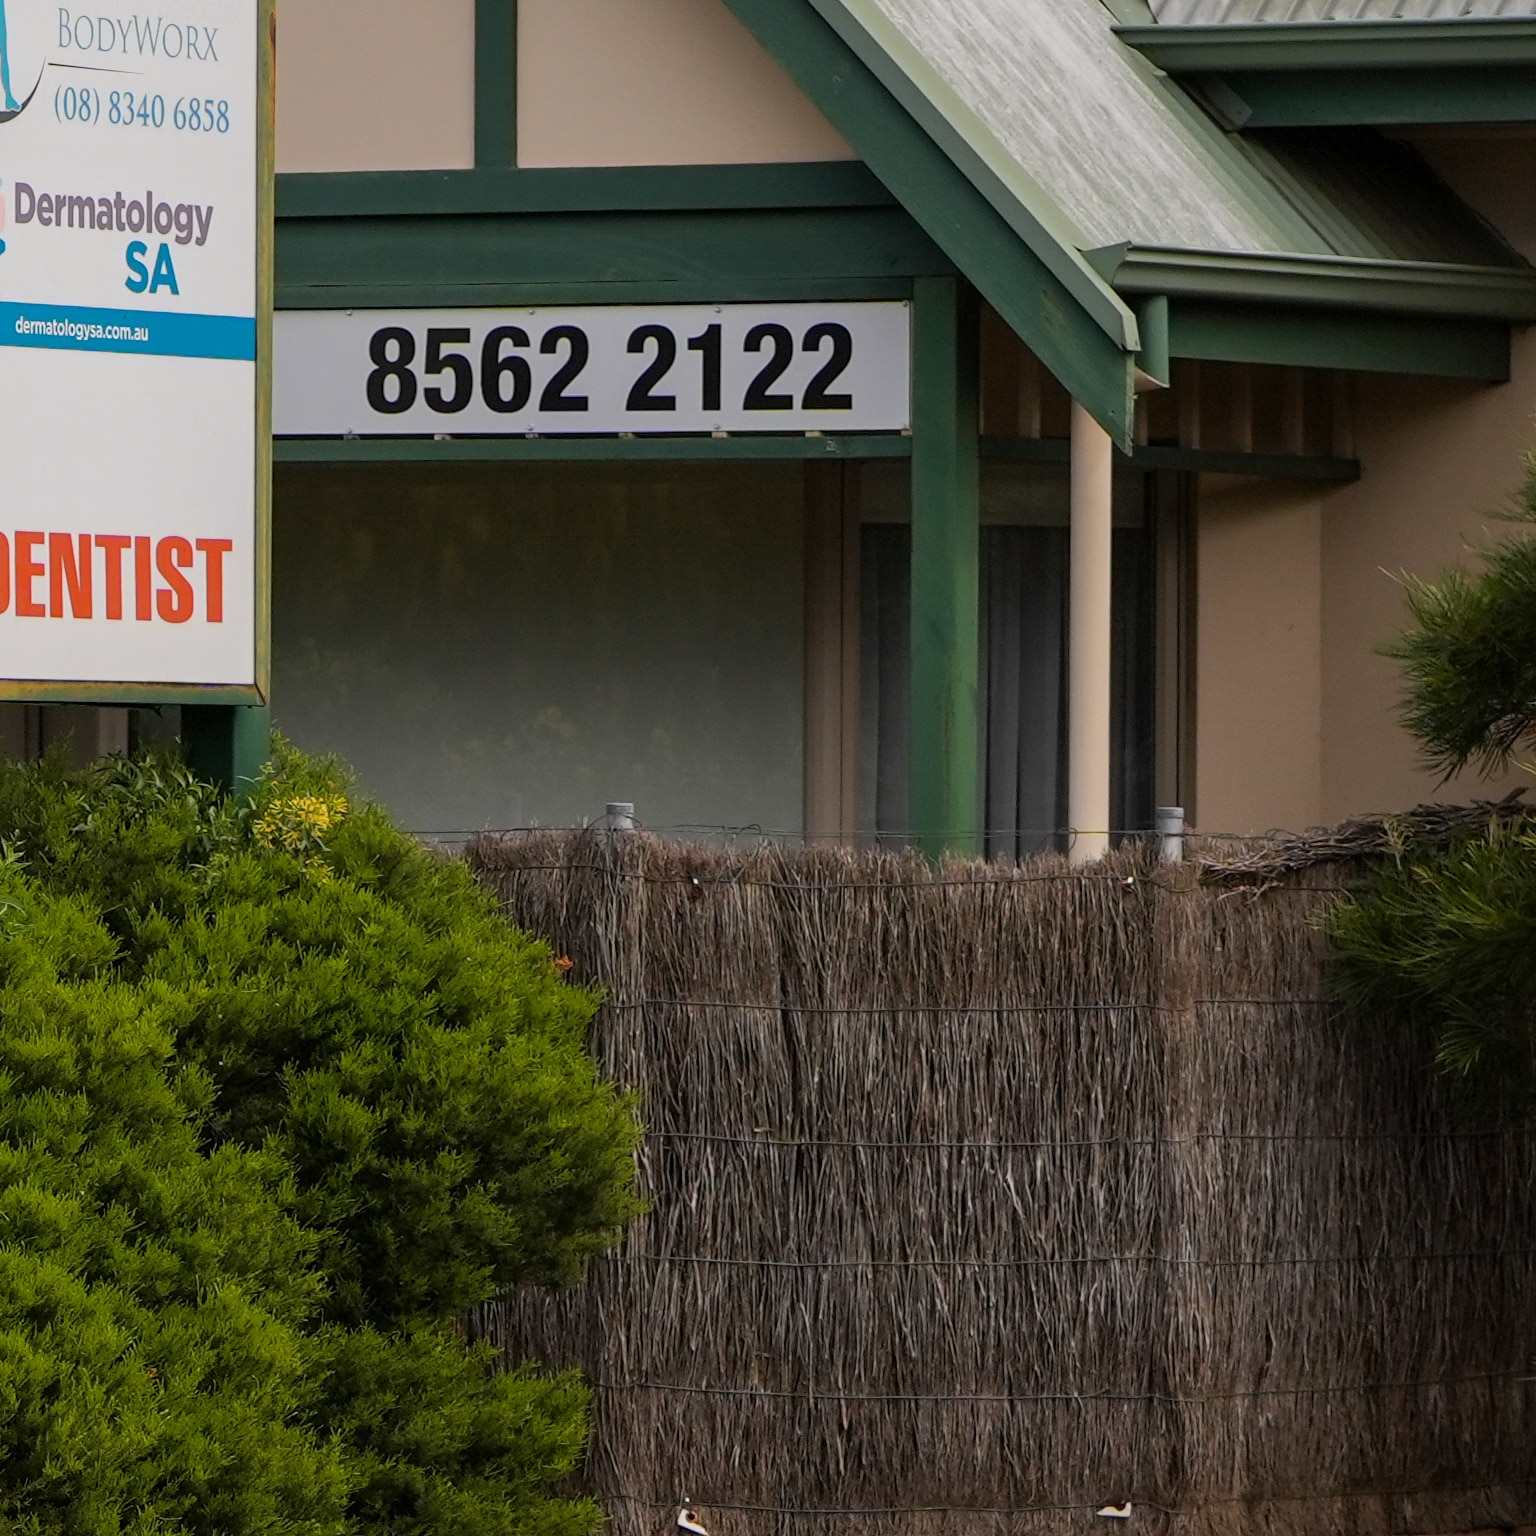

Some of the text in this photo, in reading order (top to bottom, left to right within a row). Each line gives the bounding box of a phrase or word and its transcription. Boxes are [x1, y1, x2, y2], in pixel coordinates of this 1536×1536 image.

[54, 86, 230, 133] (08) 8340 6858
[14, 182, 214, 246] Dermatology
[125, 240, 180, 295] SA
[15, 316, 149, 342] dermatologysa.com.au
[365, 323, 854, 414] 8562 2122
